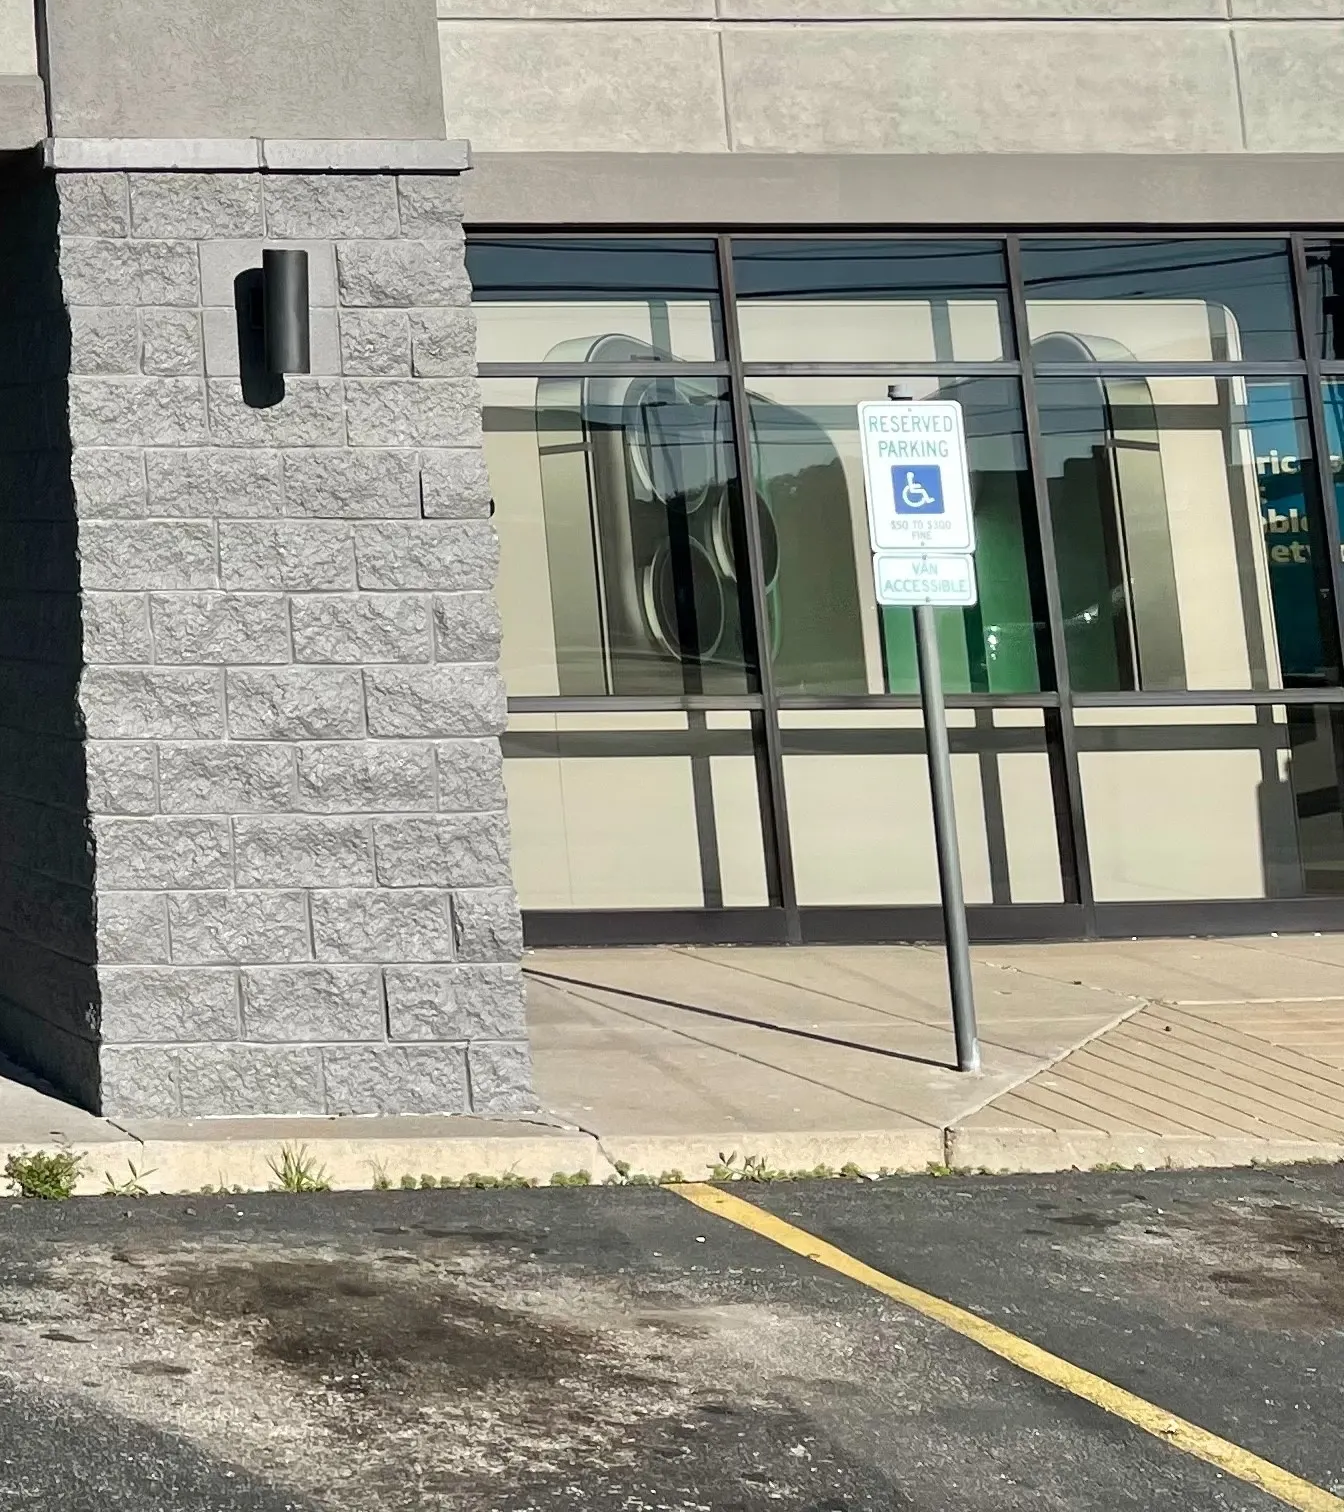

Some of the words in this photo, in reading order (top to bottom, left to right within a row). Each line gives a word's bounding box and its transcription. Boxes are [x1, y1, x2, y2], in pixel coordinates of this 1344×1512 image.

[868, 415, 953, 433] RESERVED
[878, 440, 949, 458] PARKING
[891, 520, 909, 530] $50
[912, 520, 923, 530] TO
[928, 520, 952, 530] $300
[912, 531, 932, 540] FINE
[912, 562, 938, 575] VAN
[884, 579, 968, 593] ACCESSIBLE
